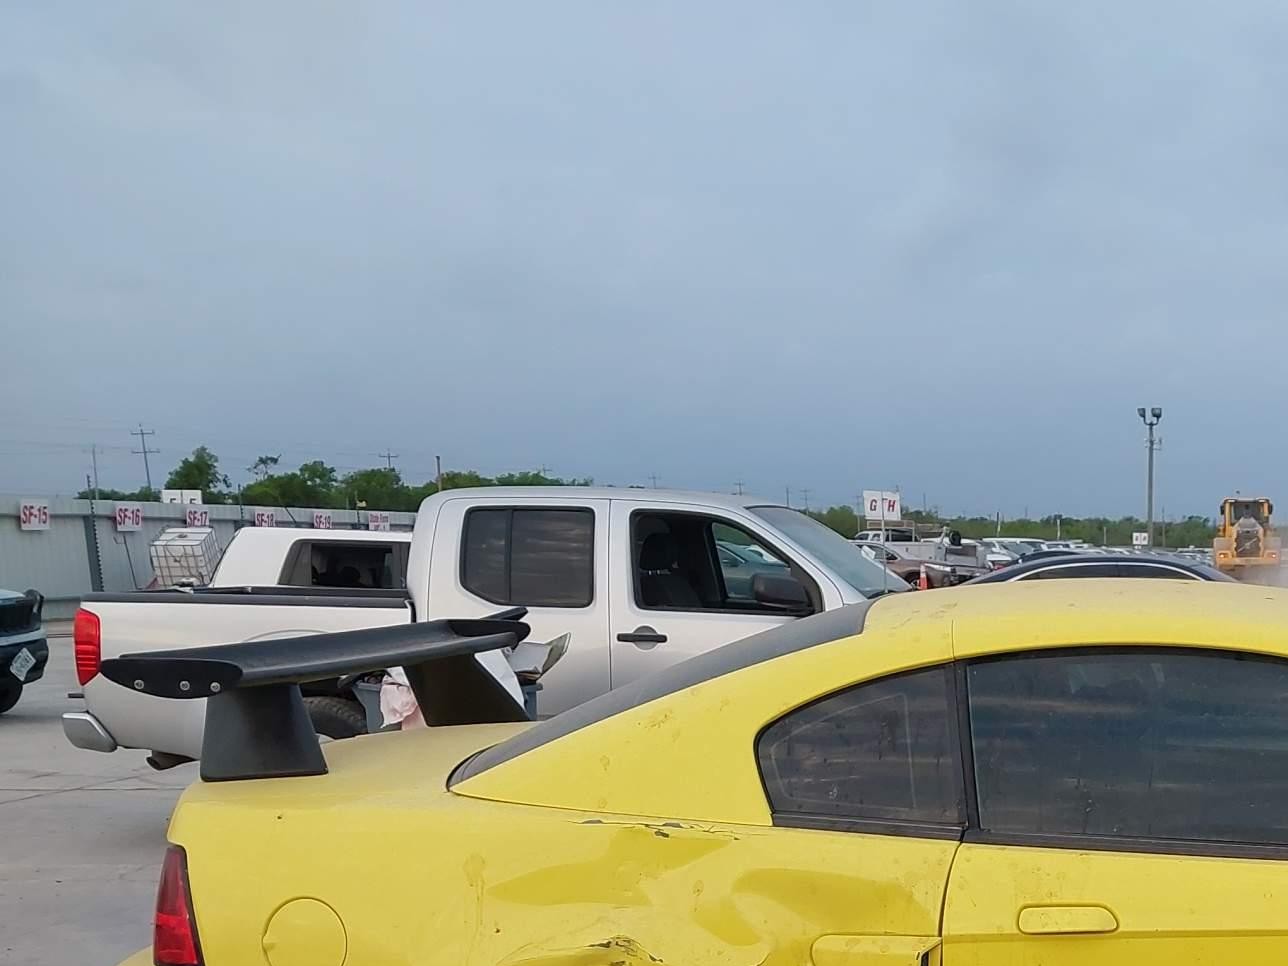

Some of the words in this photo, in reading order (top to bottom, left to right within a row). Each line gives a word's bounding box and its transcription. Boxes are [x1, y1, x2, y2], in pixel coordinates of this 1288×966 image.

[869, 498, 878, 512] G
[887, 499, 896, 513] H
[21, 505, 49, 525] SF-15
[116, 507, 142, 526] SF-16
[187, 510, 208, 526] SF-17
